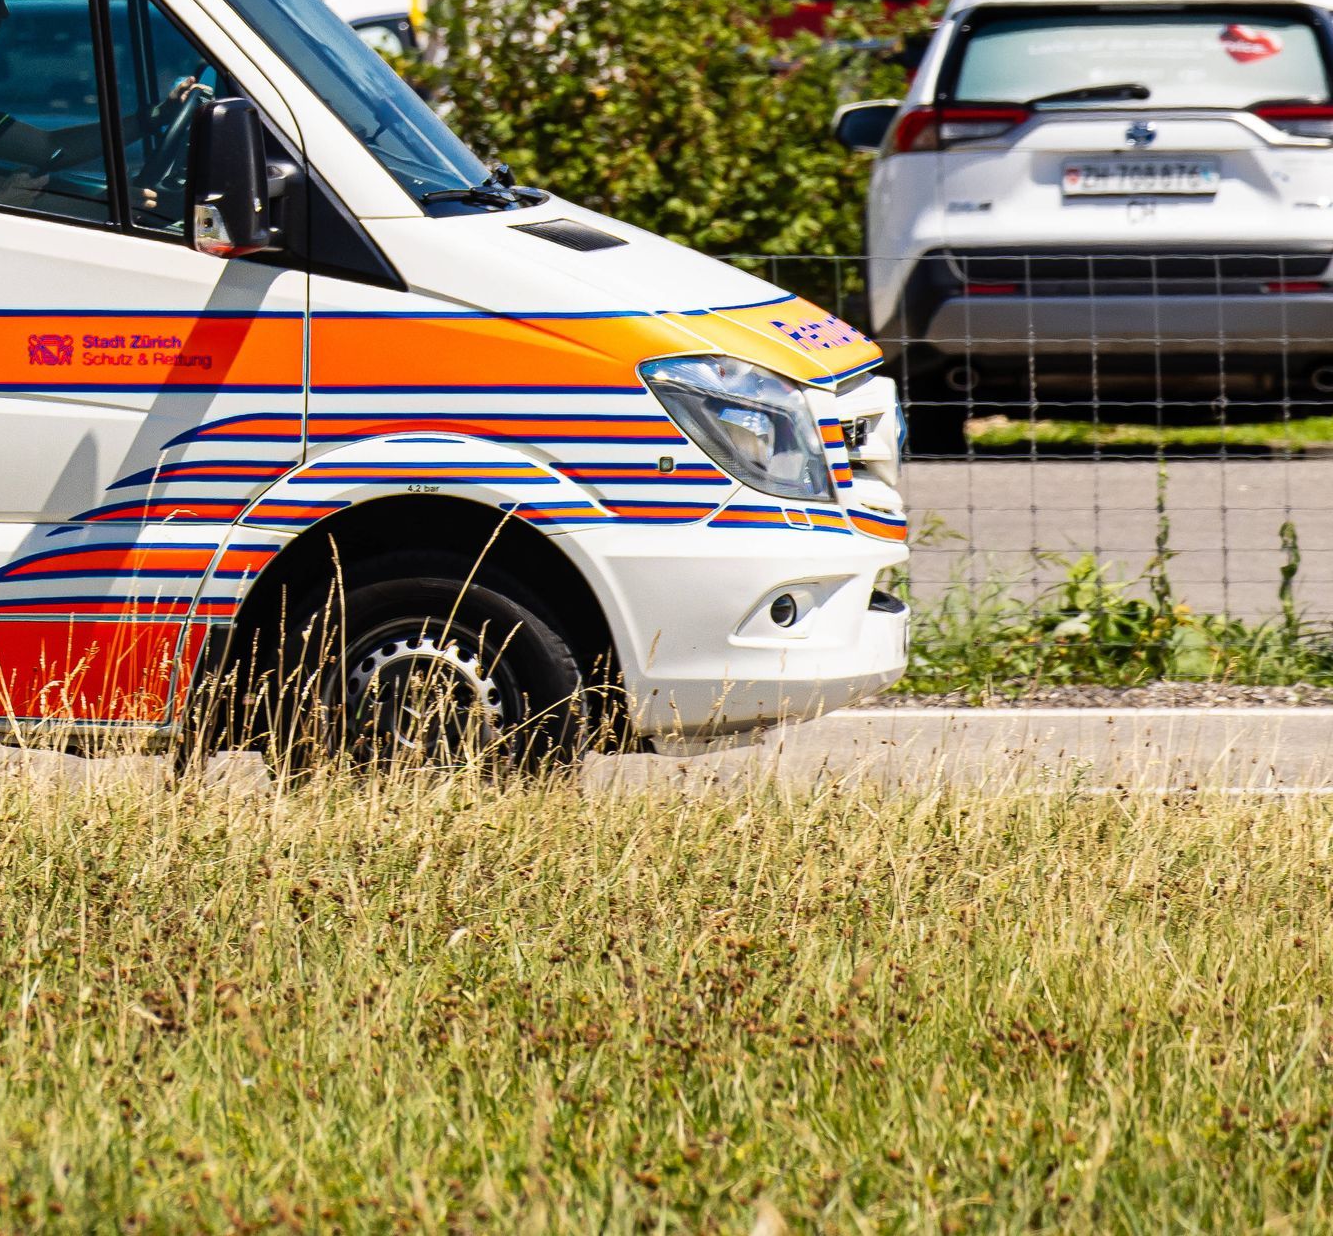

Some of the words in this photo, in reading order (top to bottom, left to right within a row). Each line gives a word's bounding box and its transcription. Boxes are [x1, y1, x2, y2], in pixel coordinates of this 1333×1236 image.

[82, 334, 127, 349] Stadt
[130, 334, 182, 349] Zürich
[82, 352, 133, 366] Schutz
[137, 352, 148, 366] &
[153, 352, 212, 369] Rettung
[423, 484, 440, 493] bar
